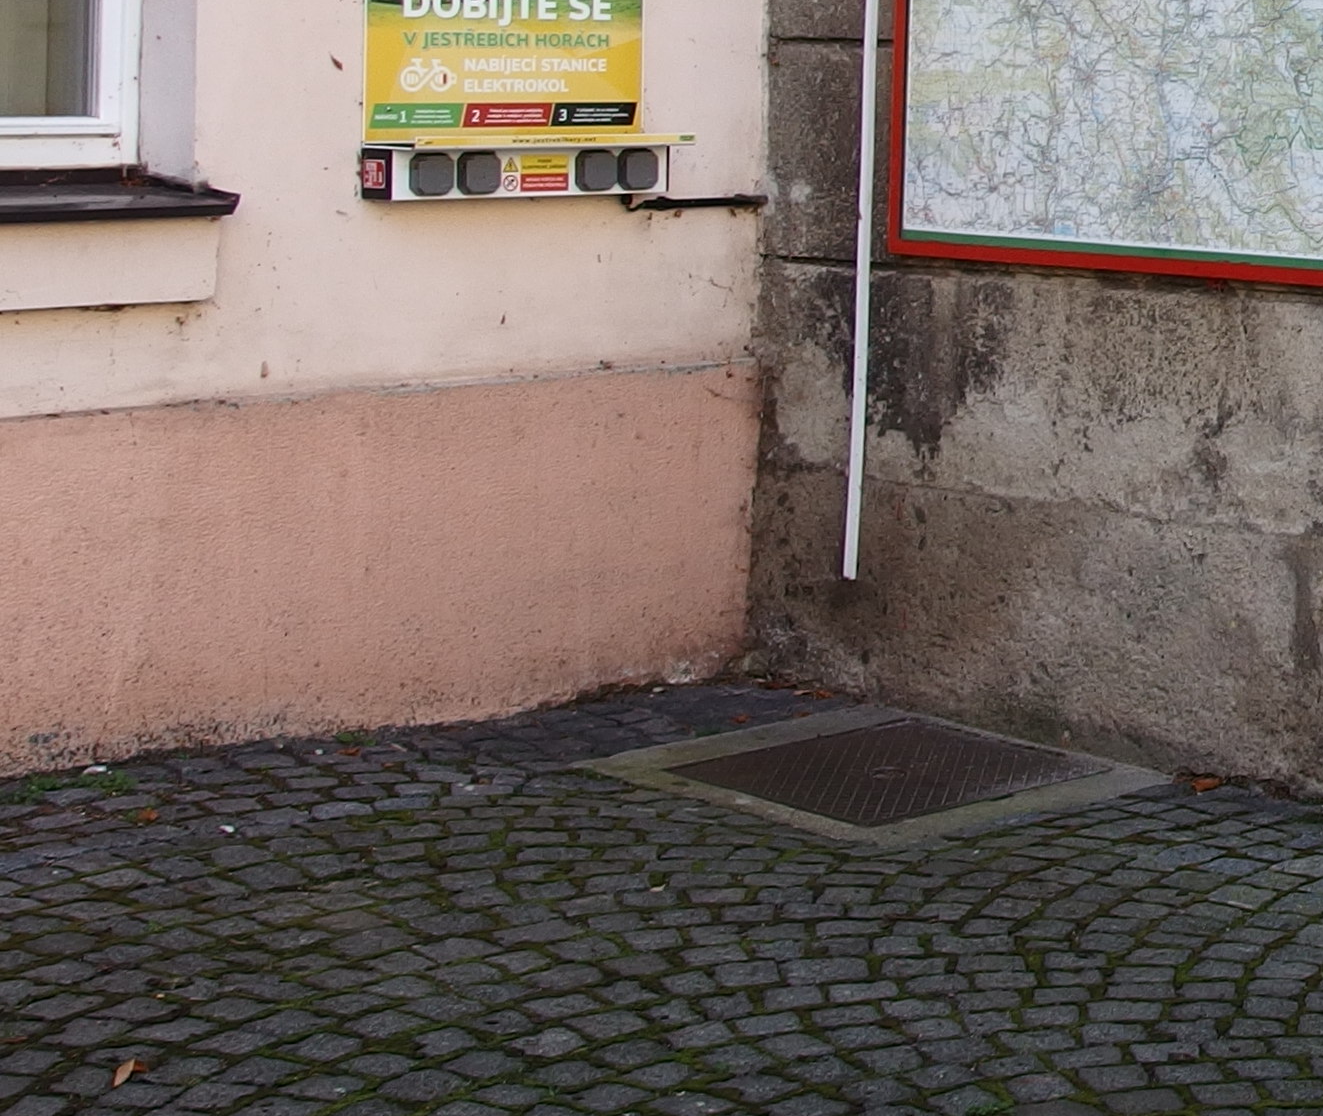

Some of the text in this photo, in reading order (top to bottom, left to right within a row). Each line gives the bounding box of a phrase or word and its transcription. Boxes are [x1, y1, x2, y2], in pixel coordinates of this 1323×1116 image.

[404, 28, 609, 49] V JESTŘEBÍCH HORÁCH
[464, 55, 607, 74] NABÍJECÍ STANICE
[464, 79, 569, 93] ELEKTROKOL
[399, 110, 406, 123] 1
[471, 110, 480, 123] 2
[559, 109, 567, 121] 3
